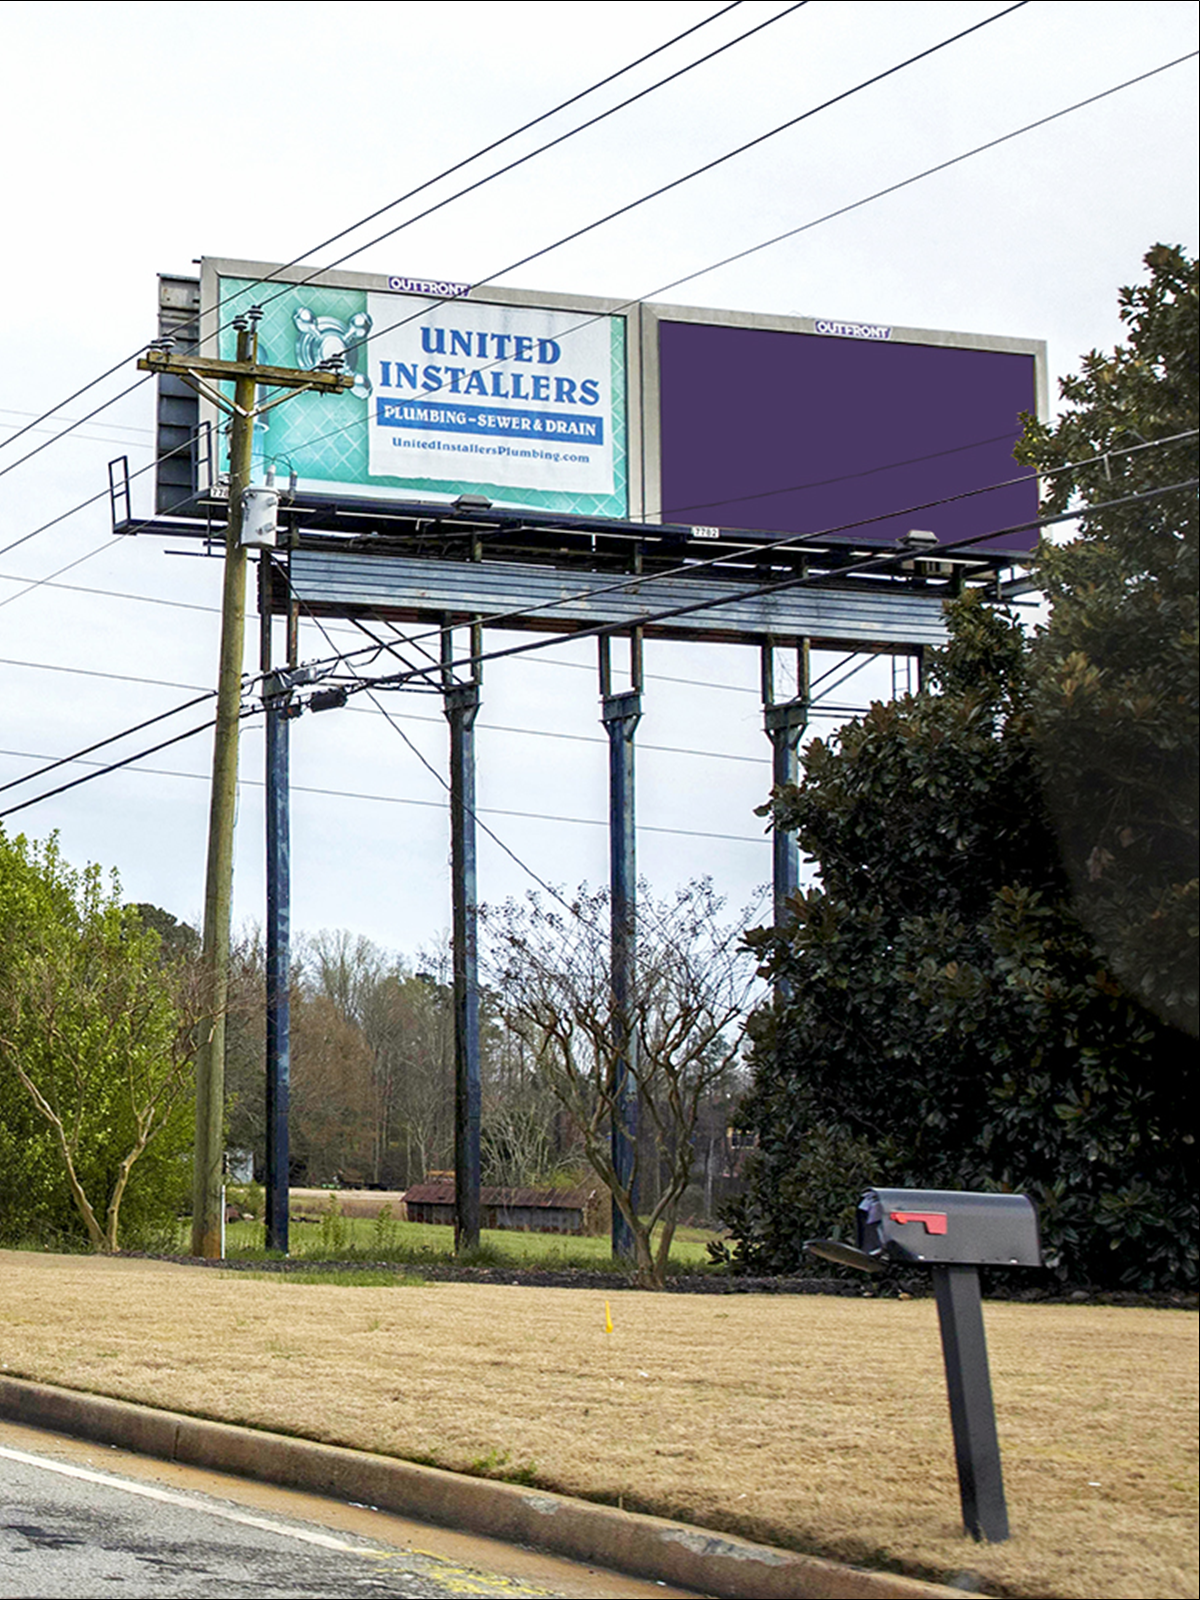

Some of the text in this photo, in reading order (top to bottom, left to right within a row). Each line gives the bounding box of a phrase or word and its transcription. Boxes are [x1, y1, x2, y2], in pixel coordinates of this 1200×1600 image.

[391, 277, 468, 297] OUTFRONT
[817, 321, 889, 339] OUTFRONT
[420, 326, 561, 365] UNITED
[379, 360, 600, 406] INSTALLERS
[533, 418, 543, 431] &
[545, 419, 596, 437] DRAIN
[392, 437, 590, 463] UnitedInstallersPlumbing.com
